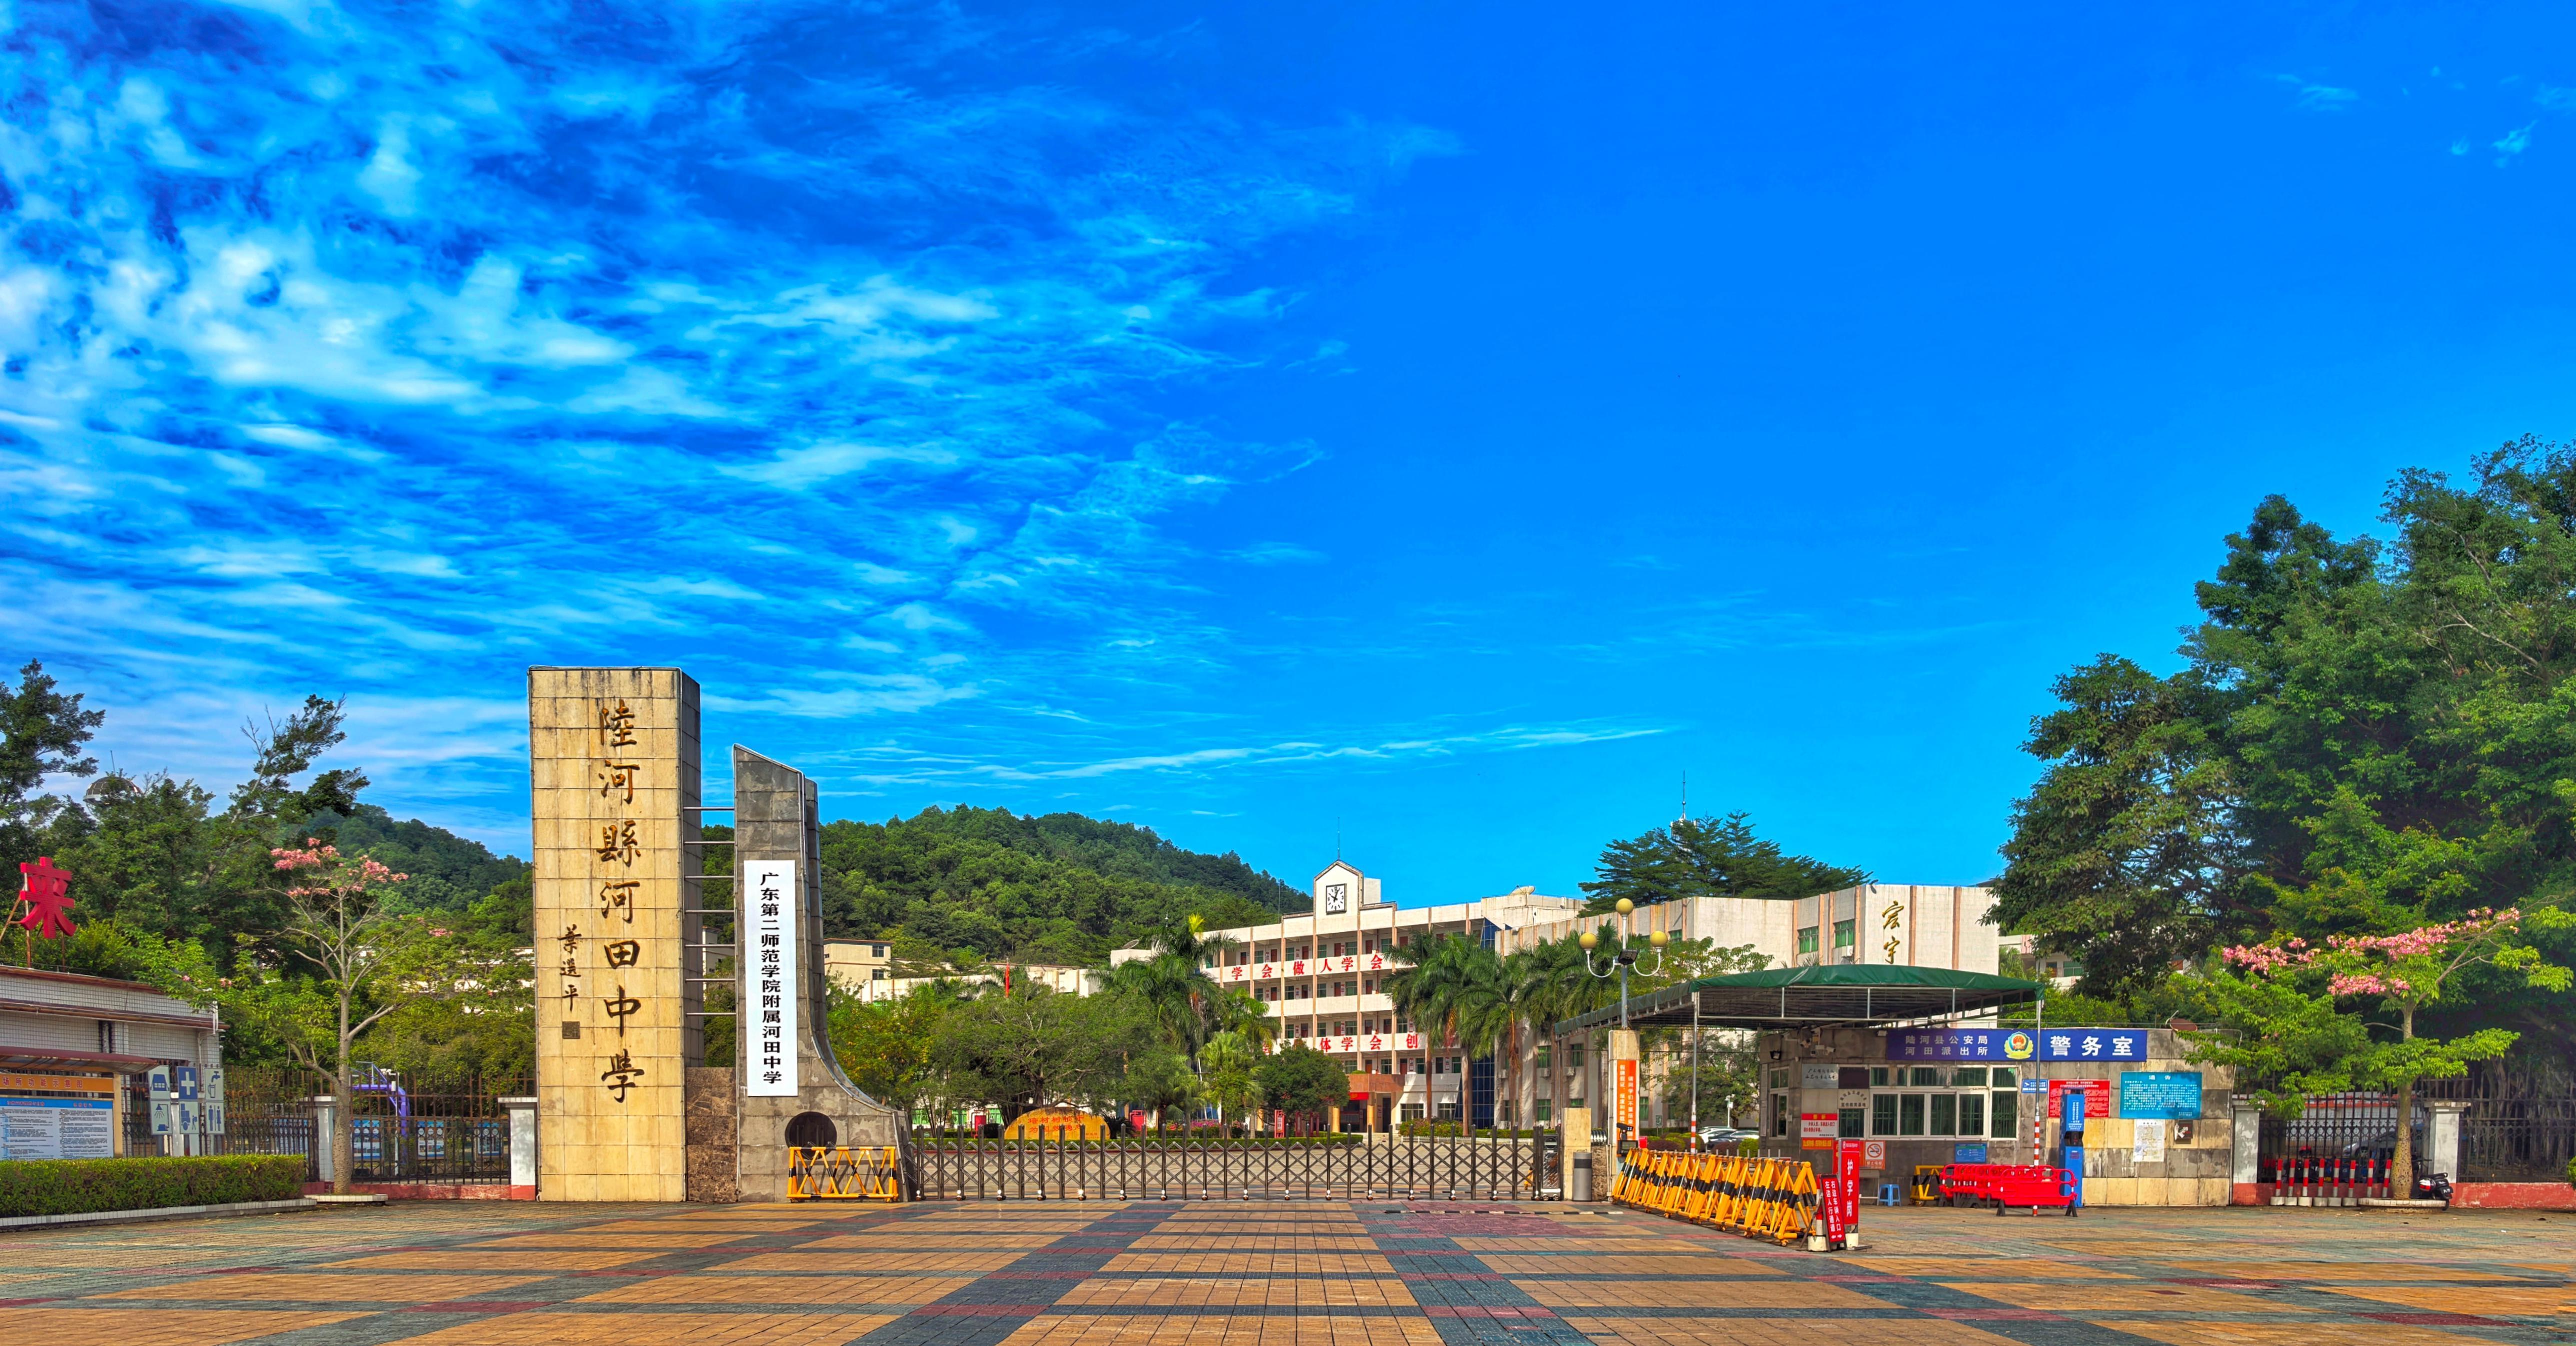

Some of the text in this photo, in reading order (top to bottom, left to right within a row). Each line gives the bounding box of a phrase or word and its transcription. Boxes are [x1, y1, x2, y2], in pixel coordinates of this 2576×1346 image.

[20, 856, 77, 939] 来
[597, 699, 645, 1103] 陸河縣河田中學
[760, 871, 783, 1085] 广东第二师范学院附属河田中学
[1905, 1035, 1988, 1045] 陆河县公安局
[1905, 1046, 1988, 1056] 河田派出所
[2050, 1035, 2134, 1057] 警务室
[3, 1076, 84, 1088] 场所功能示意图
[1830, 1180, 1841, 1231] 右边车辆入口
